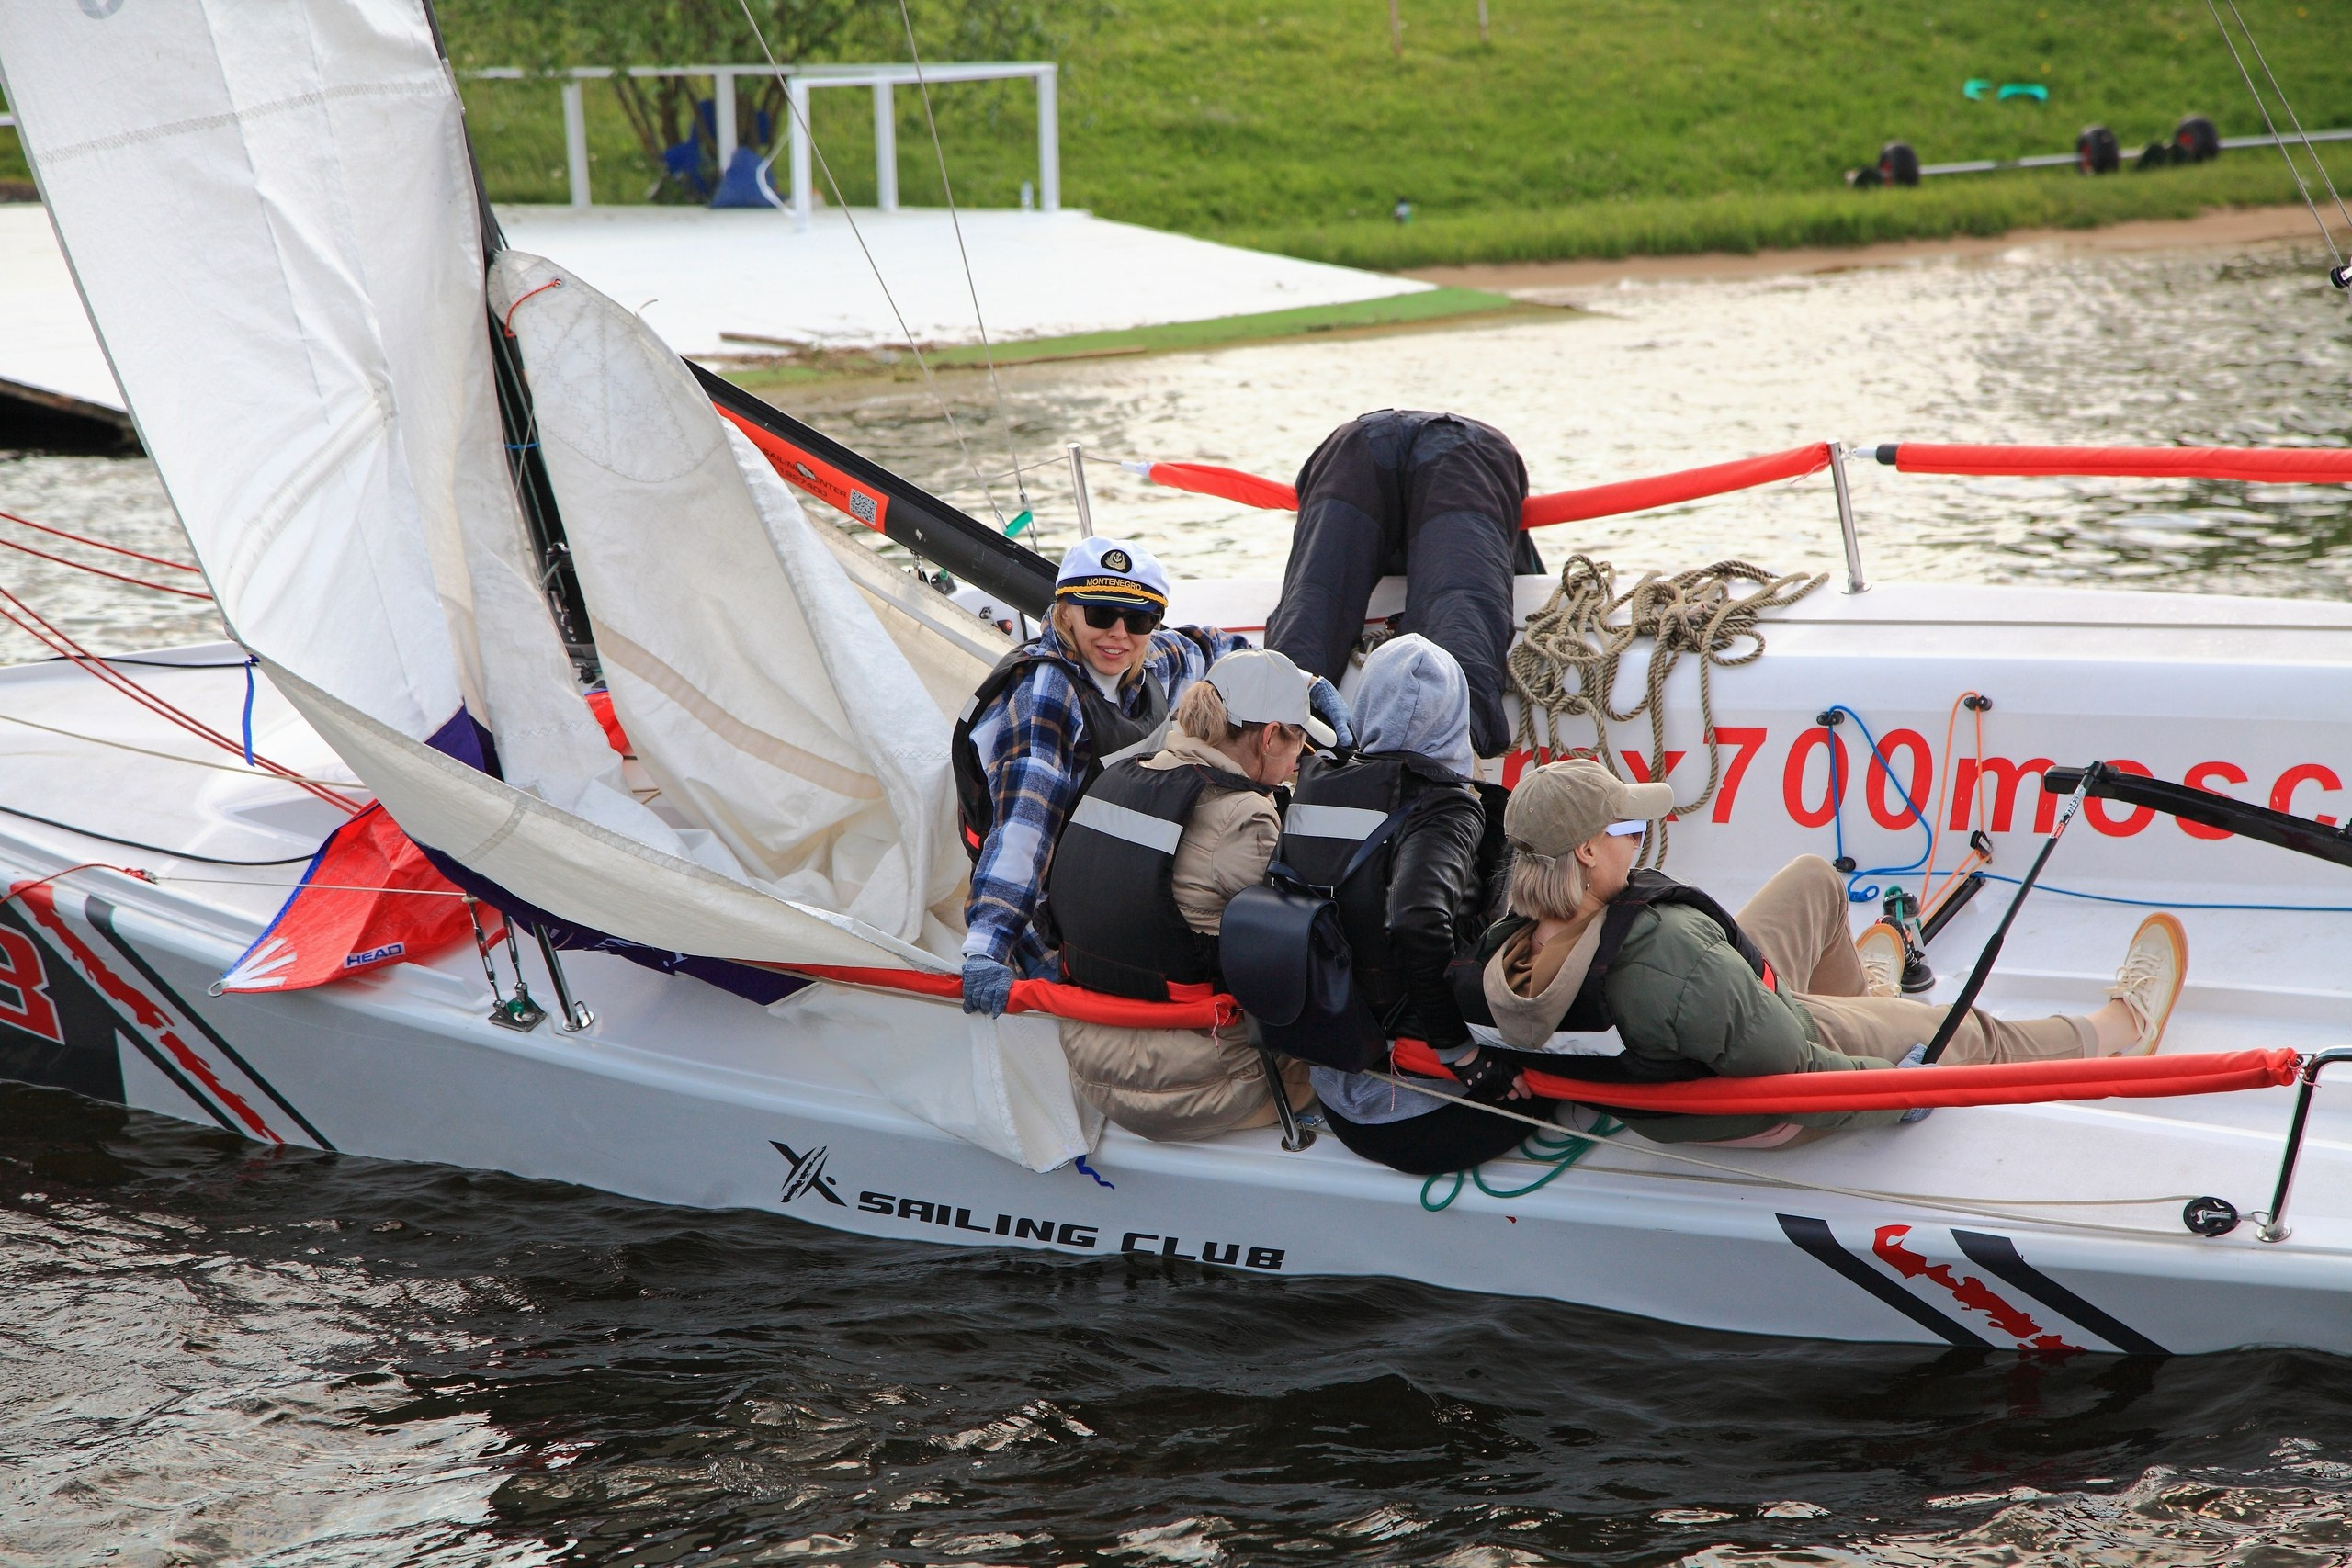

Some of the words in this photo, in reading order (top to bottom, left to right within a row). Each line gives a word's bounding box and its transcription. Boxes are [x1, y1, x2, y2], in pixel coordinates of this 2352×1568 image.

[762, 447, 799, 472] SAILIN
[810, 474, 847, 498] ENTER
[1086, 577, 1142, 591] MONTENEGRO
[346, 944, 402, 966] HEAD
[857, 1190, 1099, 1249] SAILING
[1120, 1232, 1285, 1271] CLUB
